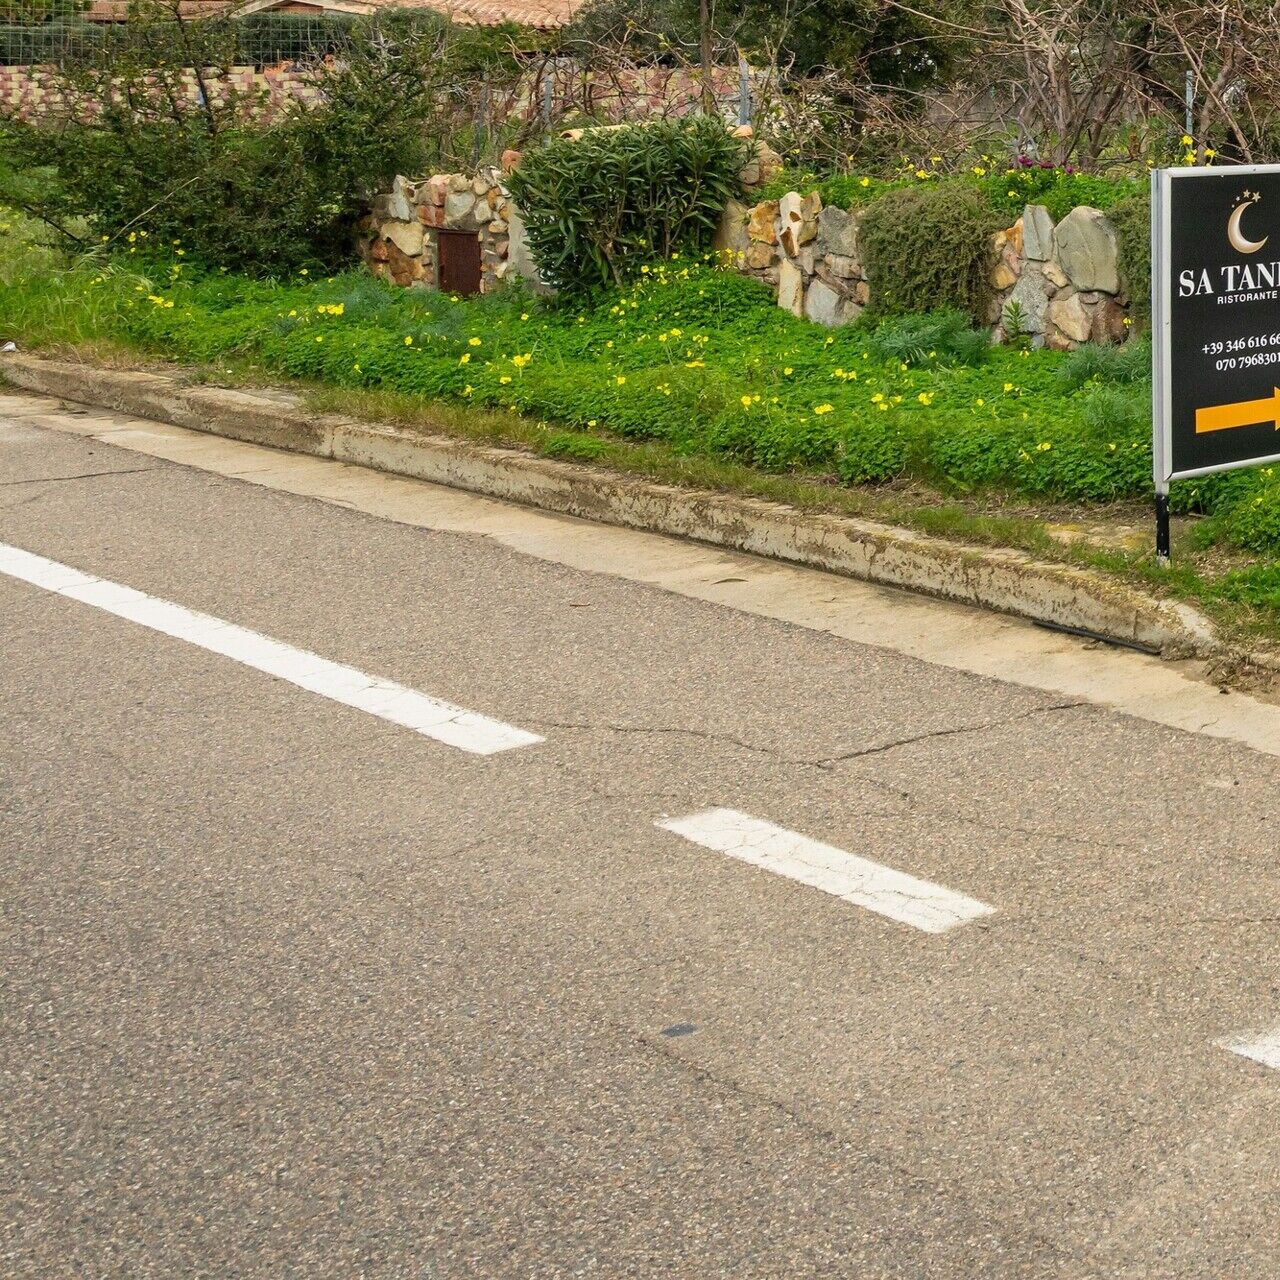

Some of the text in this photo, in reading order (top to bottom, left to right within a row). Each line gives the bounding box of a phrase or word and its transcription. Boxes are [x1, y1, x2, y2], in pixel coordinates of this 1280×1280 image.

[1179, 268, 1214, 297] SA
[1217, 290, 1278, 304] RISTORANTE
[1202, 342, 1223, 354] +39
[1225, 337, 1246, 352] 346
[1247, 334, 1268, 348] 616
[1215, 360, 1236, 371] 070
